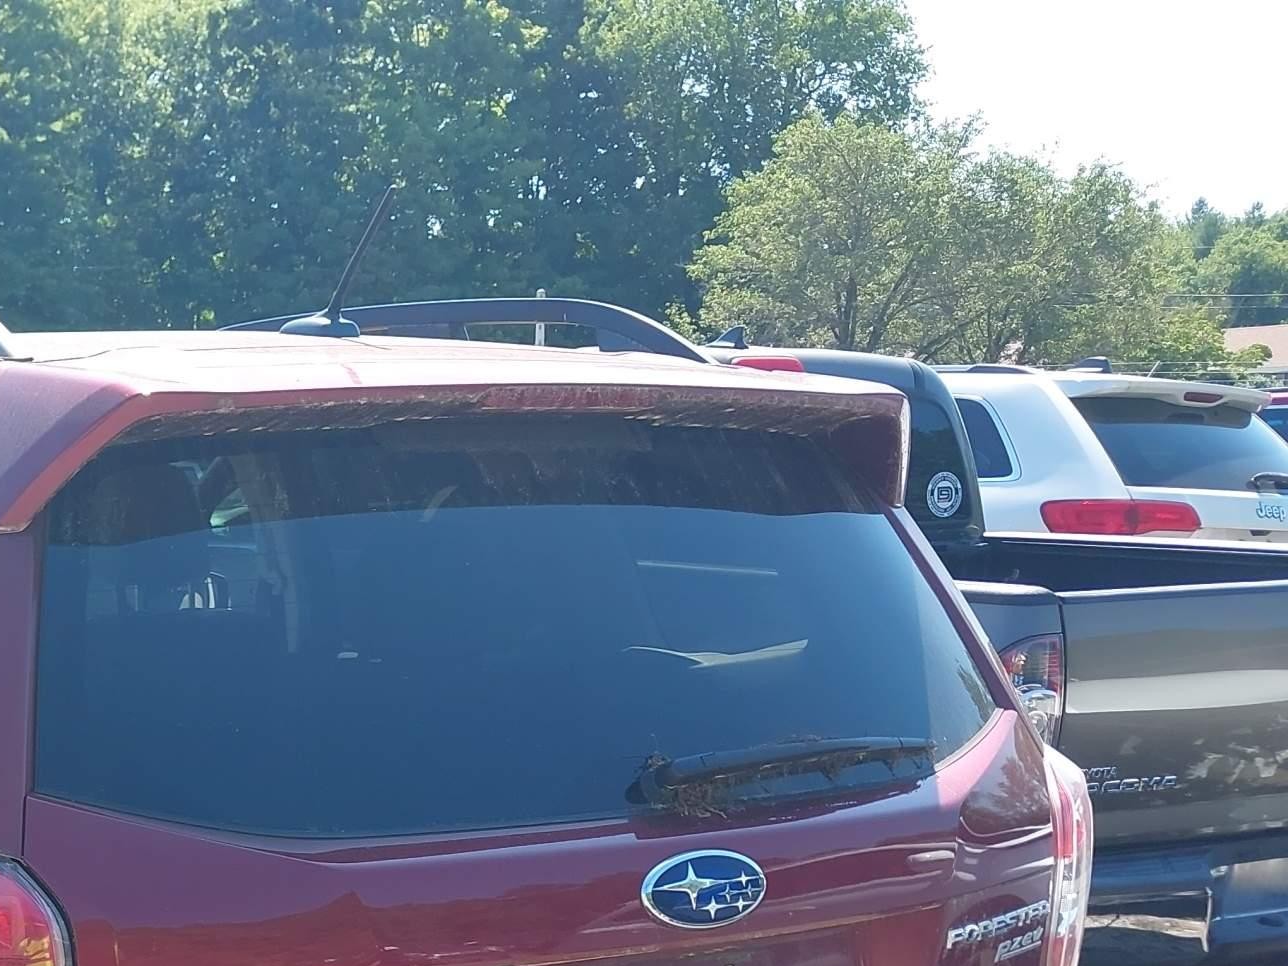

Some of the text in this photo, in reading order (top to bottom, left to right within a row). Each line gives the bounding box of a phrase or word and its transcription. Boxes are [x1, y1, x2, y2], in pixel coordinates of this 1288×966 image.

[1255, 501, 1287, 522] Jeep
[1086, 776, 1177, 792] ACOMA
[946, 900, 1051, 949] FORESTER
